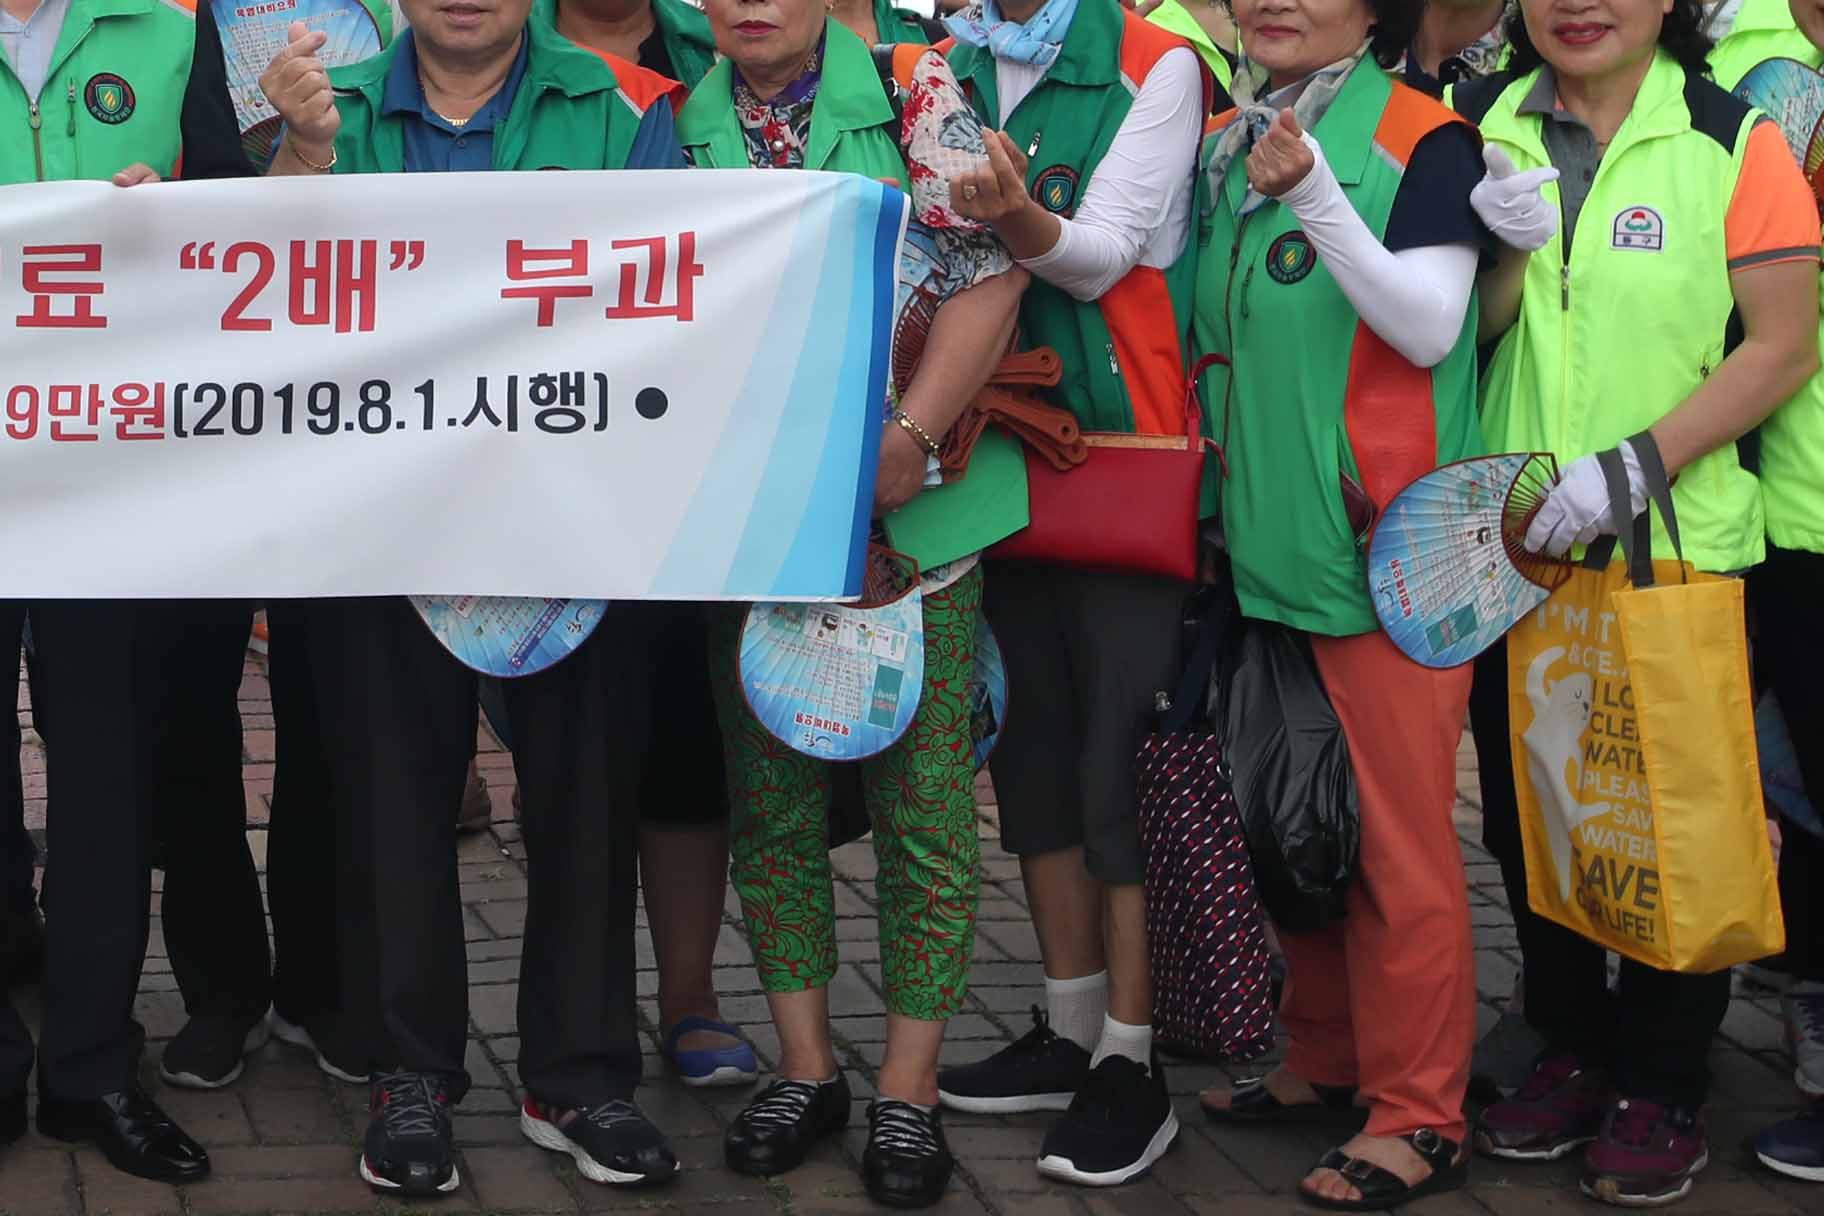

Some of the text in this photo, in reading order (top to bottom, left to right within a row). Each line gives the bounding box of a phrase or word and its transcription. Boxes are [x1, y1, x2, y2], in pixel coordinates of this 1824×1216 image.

[501, 231, 704, 328] 부과
[1590, 711, 1640, 742] CLE
[1581, 824, 1657, 862] WATER
